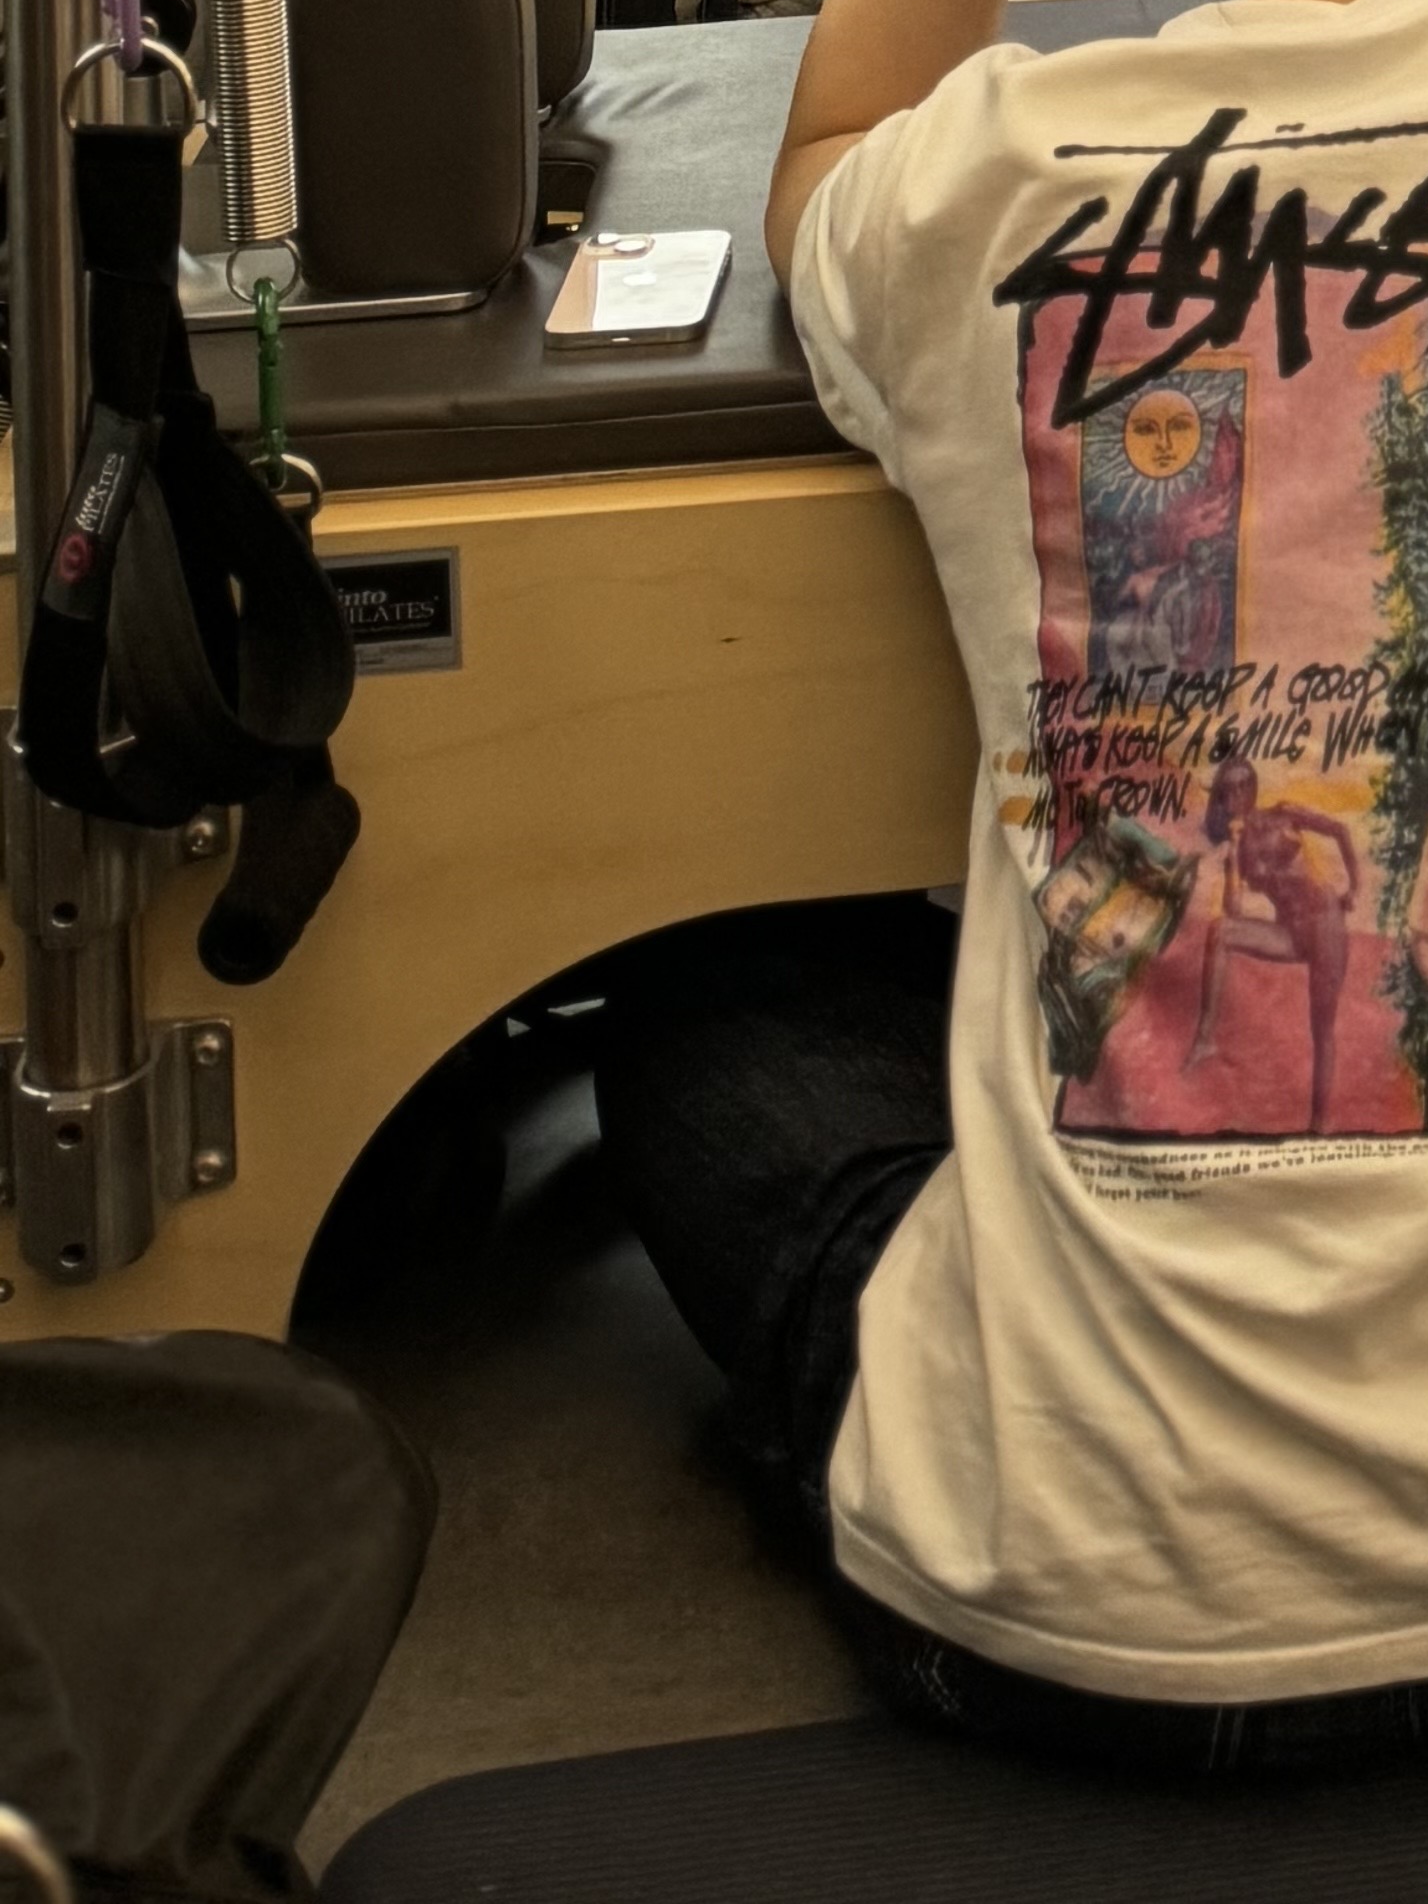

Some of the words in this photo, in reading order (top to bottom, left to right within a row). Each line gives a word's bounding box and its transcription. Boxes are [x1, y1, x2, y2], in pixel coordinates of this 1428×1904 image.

[349, 601, 435, 625] ILATES
[1158, 662, 1257, 720] KEEP
[1250, 663, 1279, 707] A
[1287, 661, 1392, 716] GOOD
[1104, 716, 1190, 774] KEEP
[1179, 713, 1213, 769] A
[1207, 712, 1312, 764] SMILE
[1322, 706, 1420, 772] WHEN
